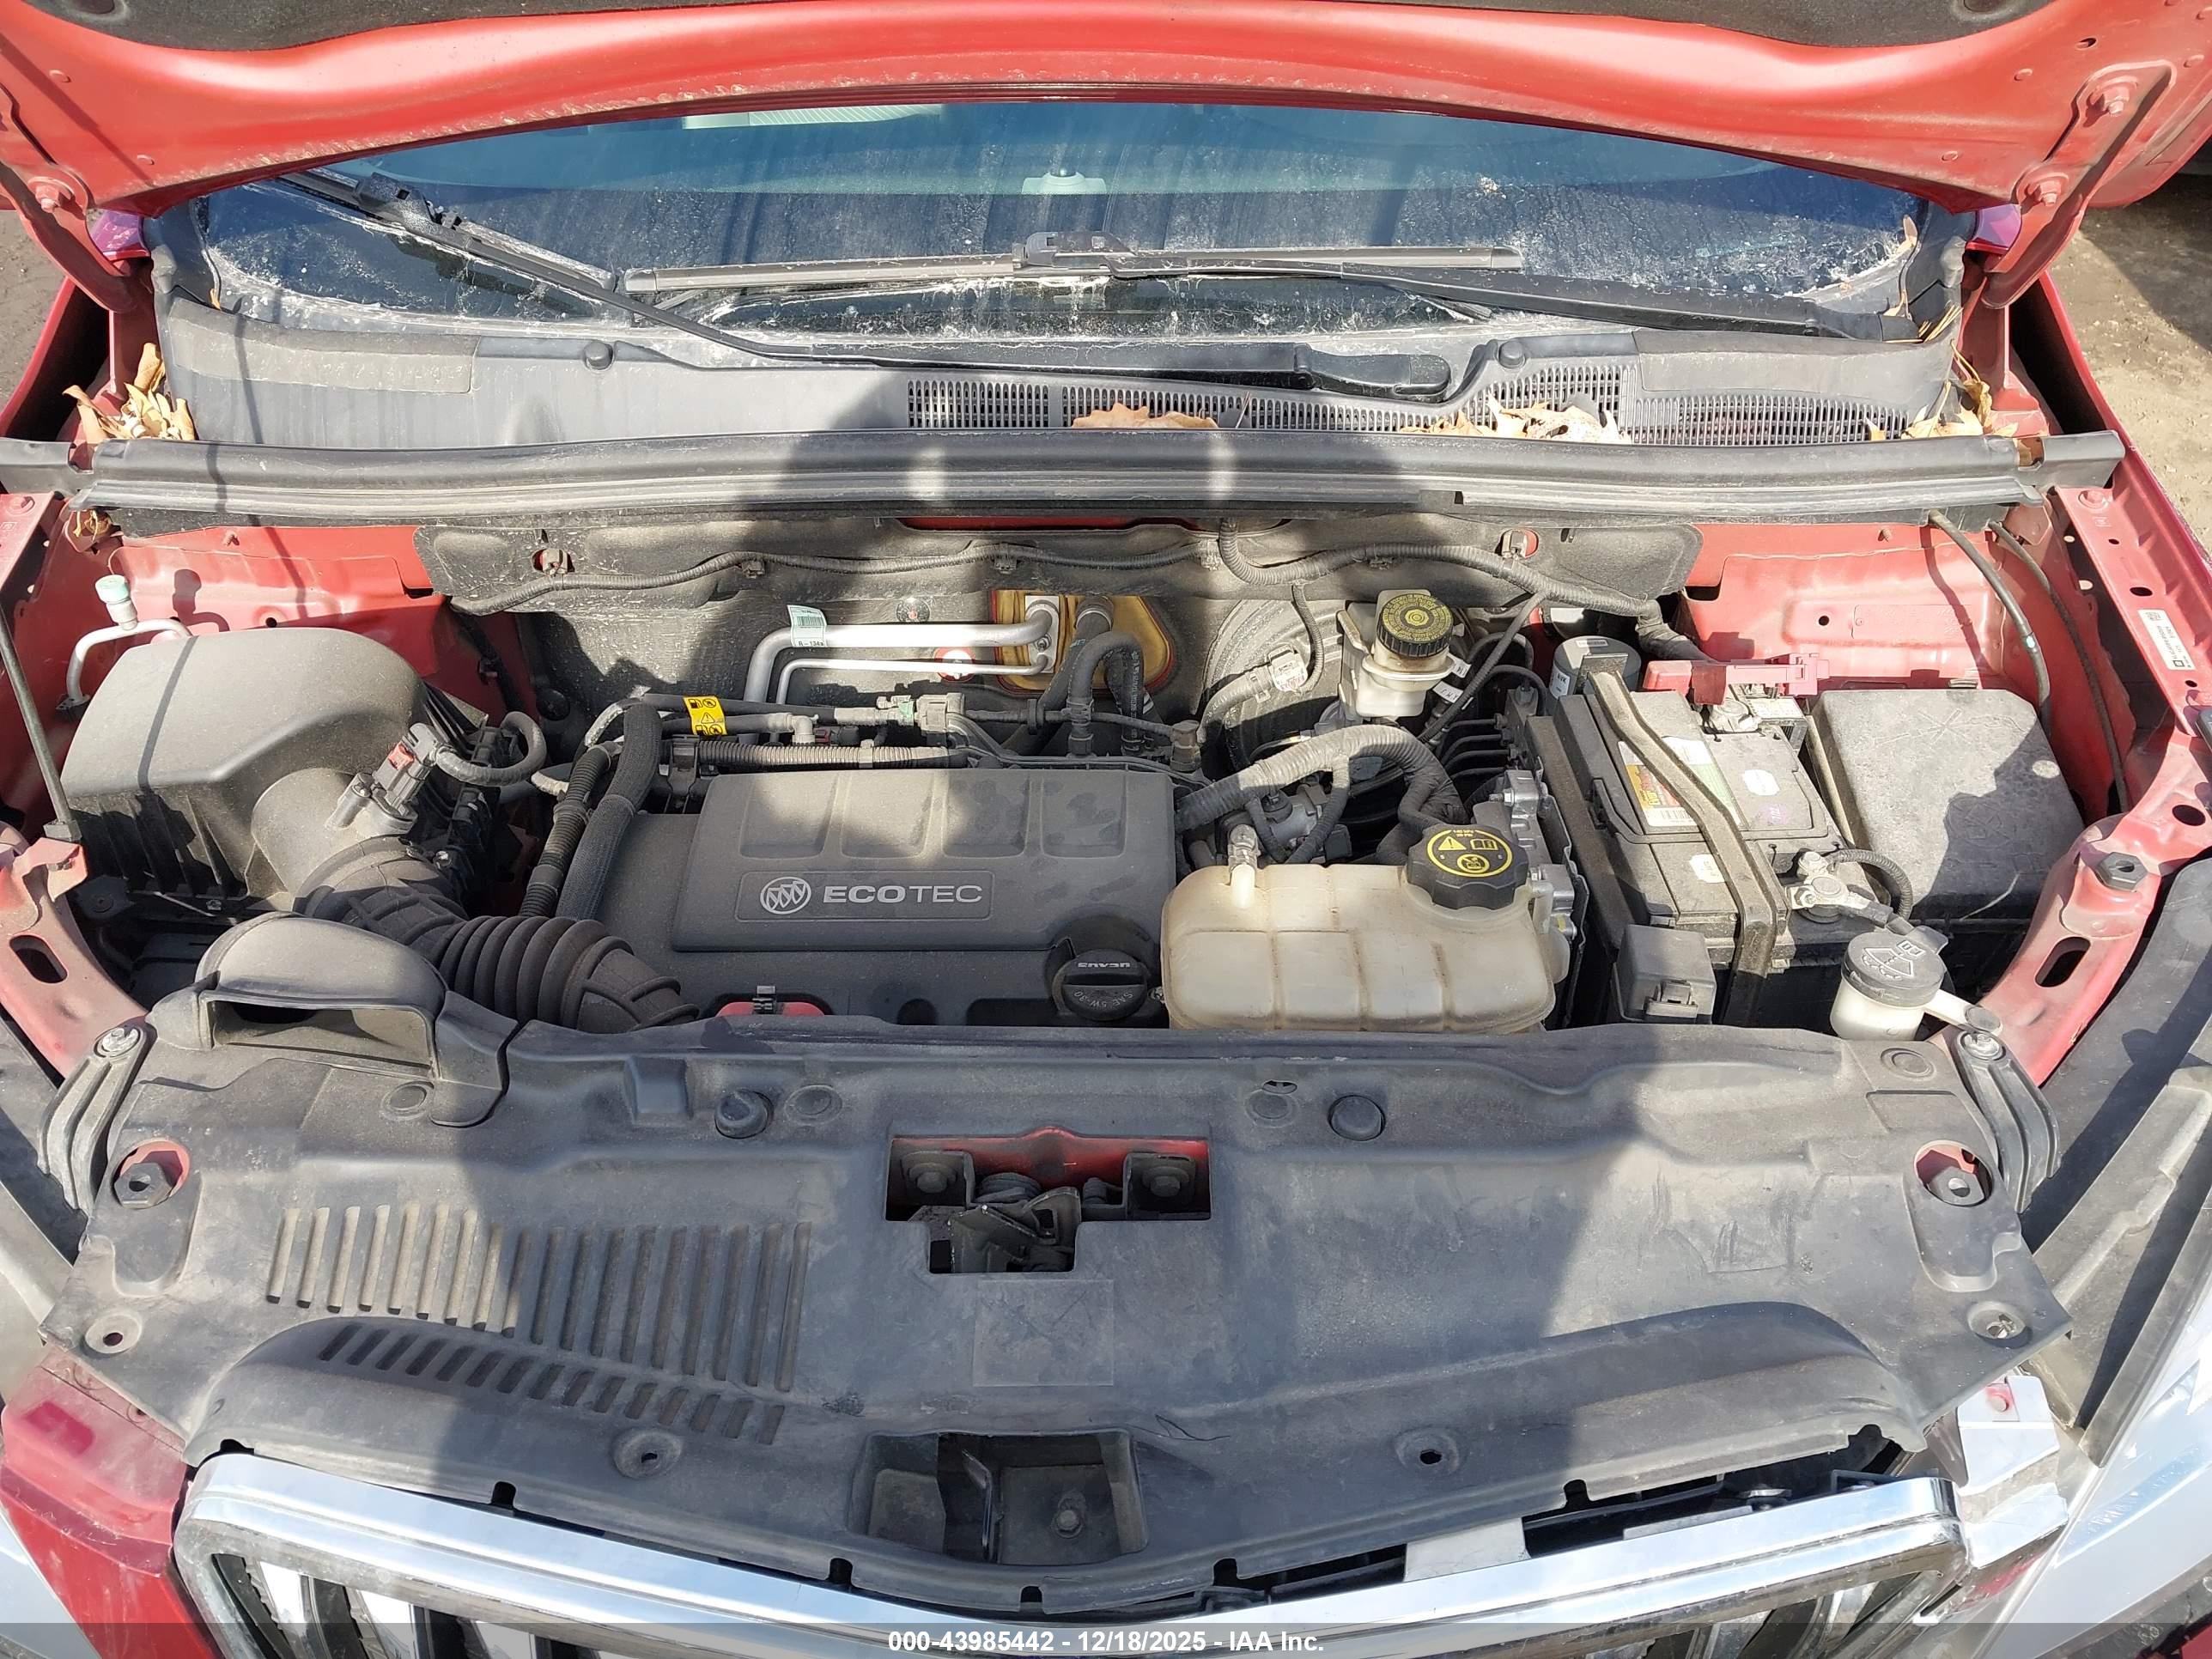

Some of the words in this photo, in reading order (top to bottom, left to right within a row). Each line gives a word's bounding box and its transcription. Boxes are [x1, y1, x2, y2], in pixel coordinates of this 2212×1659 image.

[823, 885, 982, 903] ECOTEC
[1073, 990, 1108, 1008] 5W-30
[1112, 991, 1133, 1006] SAE
